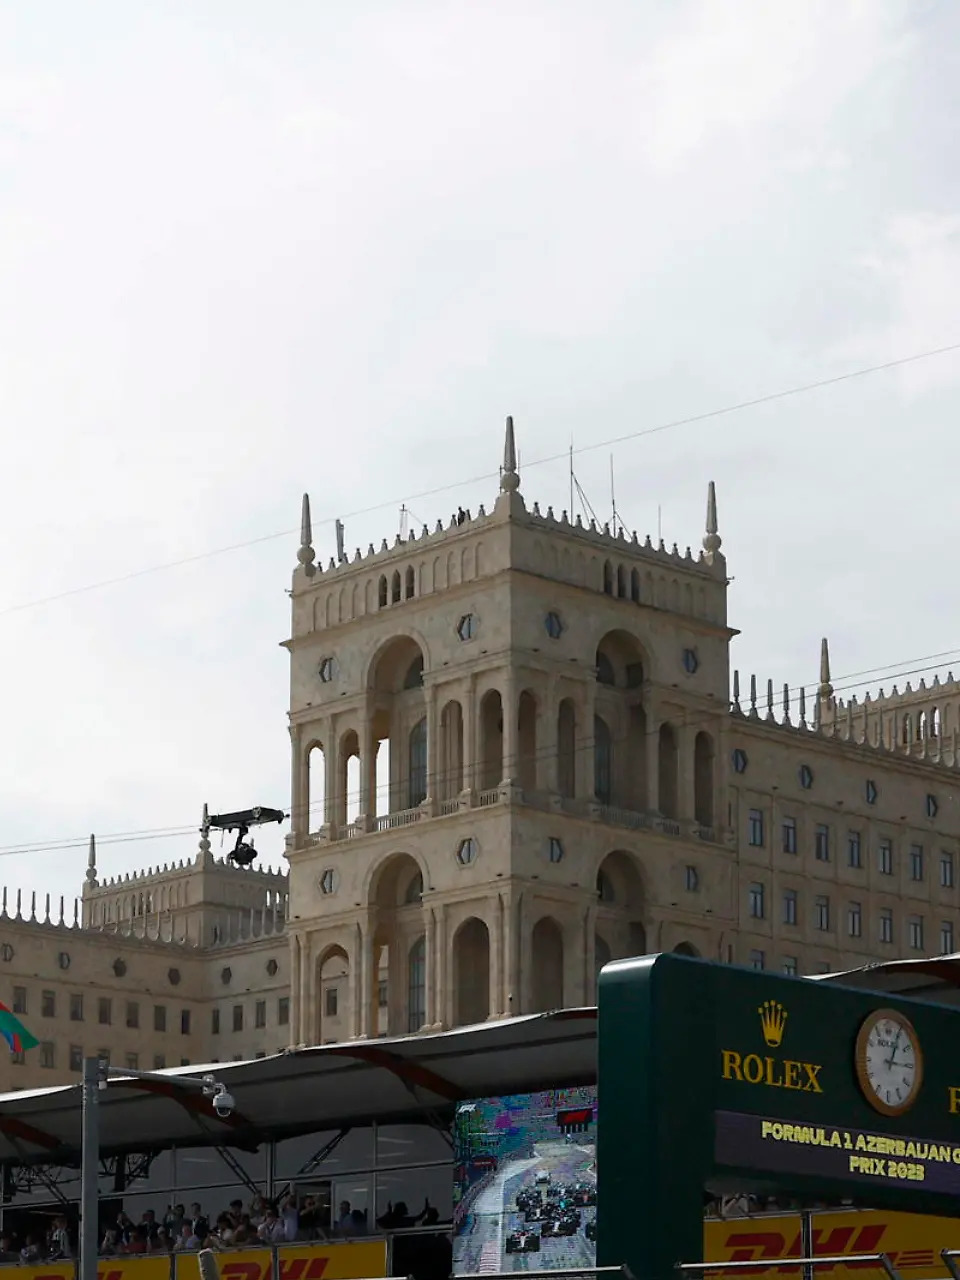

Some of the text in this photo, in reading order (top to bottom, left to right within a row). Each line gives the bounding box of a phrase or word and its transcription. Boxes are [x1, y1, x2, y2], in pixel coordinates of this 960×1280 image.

[721, 1049, 824, 1093] ROLEX
[761, 1121, 842, 1148] FORMULA
[843, 1132, 853, 1150] 1
[855, 1134, 951, 1162] AZERBAIJAN
[848, 1155, 925, 1181] PRIX 2023
[721, 1225, 896, 1275] DHL
